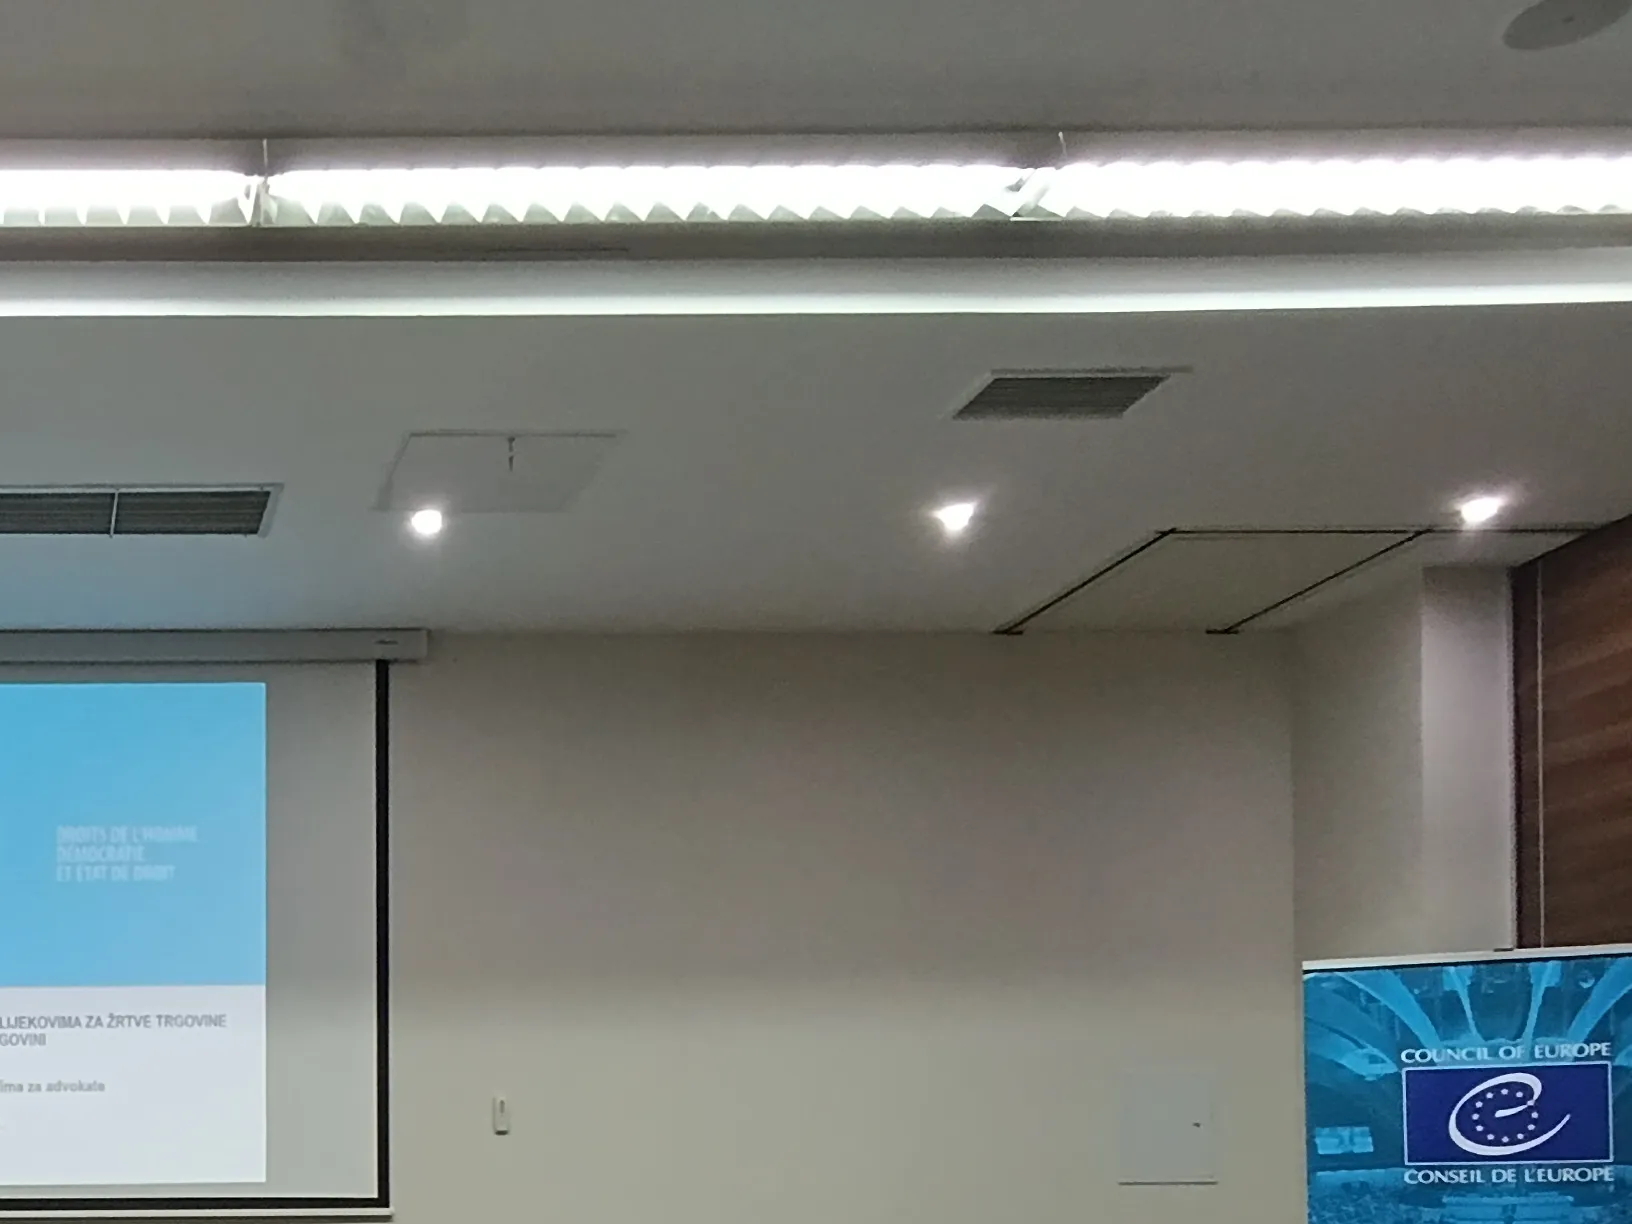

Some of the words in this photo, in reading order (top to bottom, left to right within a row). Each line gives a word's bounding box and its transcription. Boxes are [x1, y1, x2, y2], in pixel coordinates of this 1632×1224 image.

[0, 1015, 82, 1029] LIJEKOVIMA
[85, 1015, 103, 1028] ZA
[107, 1012, 151, 1028] ŽRTVE
[157, 1014, 226, 1028] TRGOVINE
[1401, 1047, 1490, 1064] COUNCIL
[1499, 1045, 1525, 1060] OF
[1534, 1042, 1612, 1059] EUROPE
[28, 1083, 42, 1093] za
[46, 1080, 105, 1094] advokate
[1404, 1169, 1485, 1185] CONSEIL
[1491, 1169, 1517, 1183] DE
[1524, 1166, 1615, 1183] L'EUROPE
